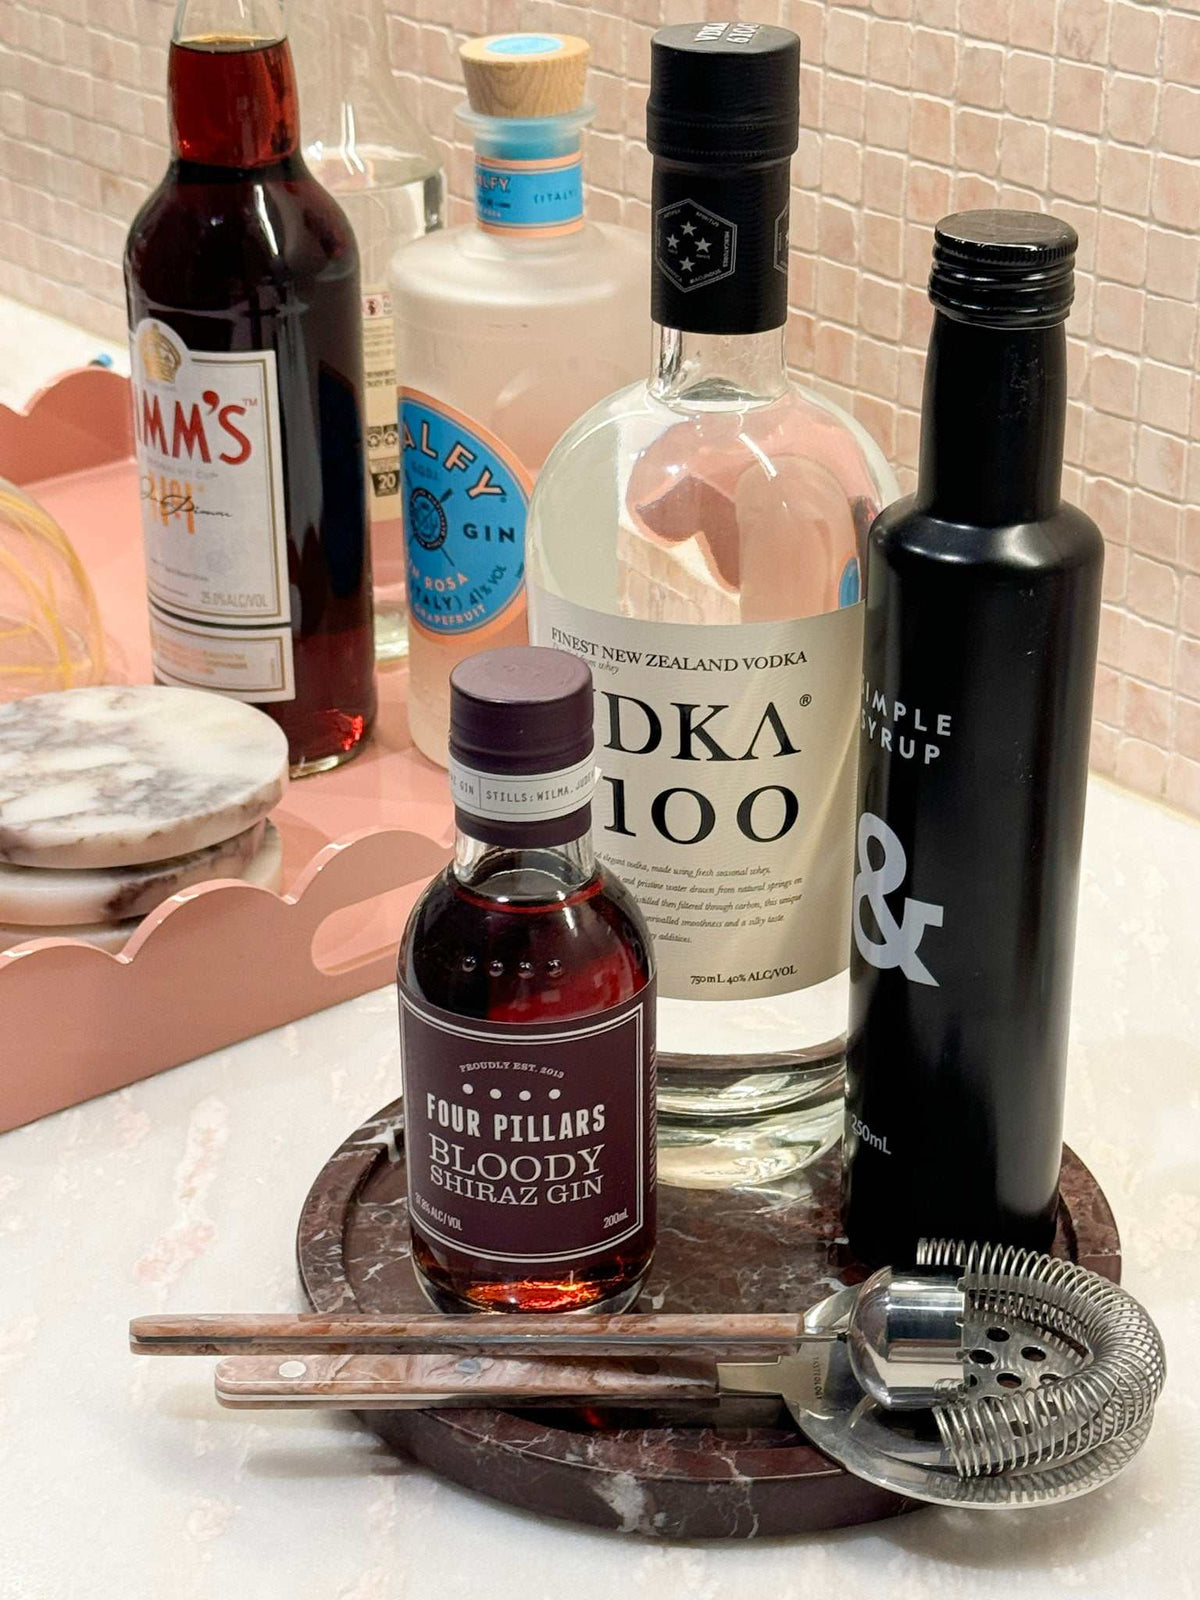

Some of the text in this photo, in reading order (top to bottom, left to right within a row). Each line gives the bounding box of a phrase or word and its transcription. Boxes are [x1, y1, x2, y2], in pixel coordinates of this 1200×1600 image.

[378, 472, 397, 489] 20
[463, 523, 516, 543] GIN
[487, 564, 507, 585] VOL
[551, 626, 599, 656] FINEST
[602, 645, 643, 664] NEW
[645, 652, 739, 672] ZEALAND
[742, 650, 808, 671] VODKA
[723, 918, 740, 927] and
[726, 974, 746, 985] 40%
[747, 965, 798, 982] ALC/VOL
[459, 1061, 565, 1079] PROUDLY EST. 2013
[426, 1092, 605, 1143] FOUR PILLARS
[851, 1113, 892, 1155] 250mL
[428, 1133, 606, 1183] BLOODY
[430, 1164, 604, 1206] SHIRAZ GIN
[602, 1207, 629, 1229] 200mL
